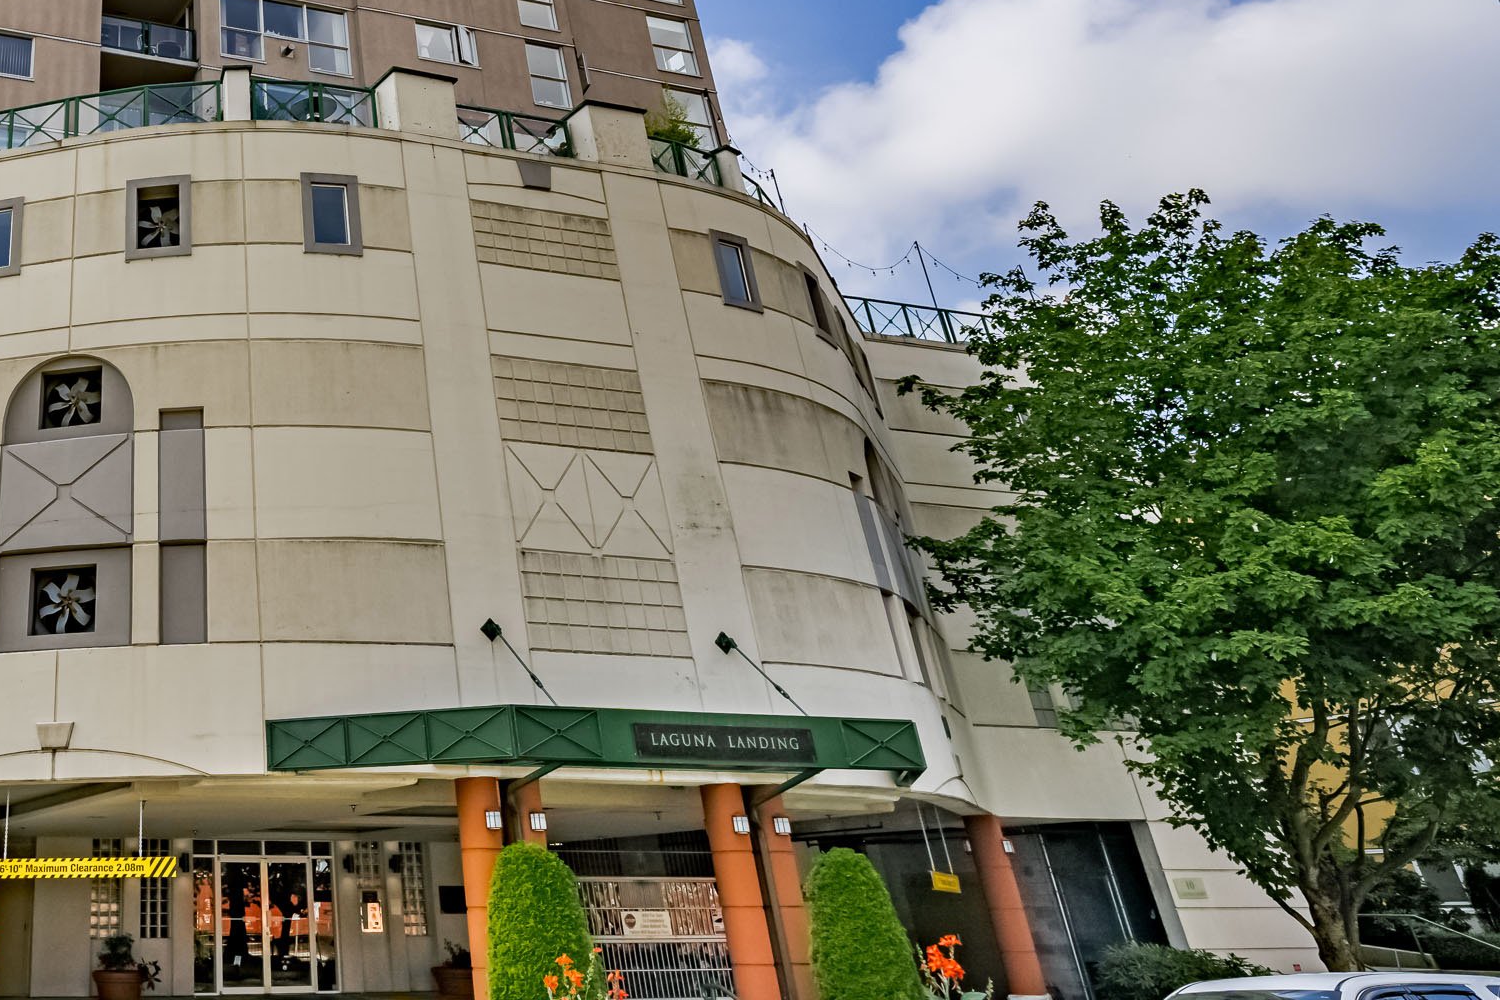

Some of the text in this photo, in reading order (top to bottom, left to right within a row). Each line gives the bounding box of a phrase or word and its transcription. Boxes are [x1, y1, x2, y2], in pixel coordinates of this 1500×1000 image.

[651, 733, 799, 750] LAGUNA LANDING
[25, 864, 68, 873] Maximum
[70, 863, 114, 873] Clearance
[116, 863, 145, 873] 2.08m
